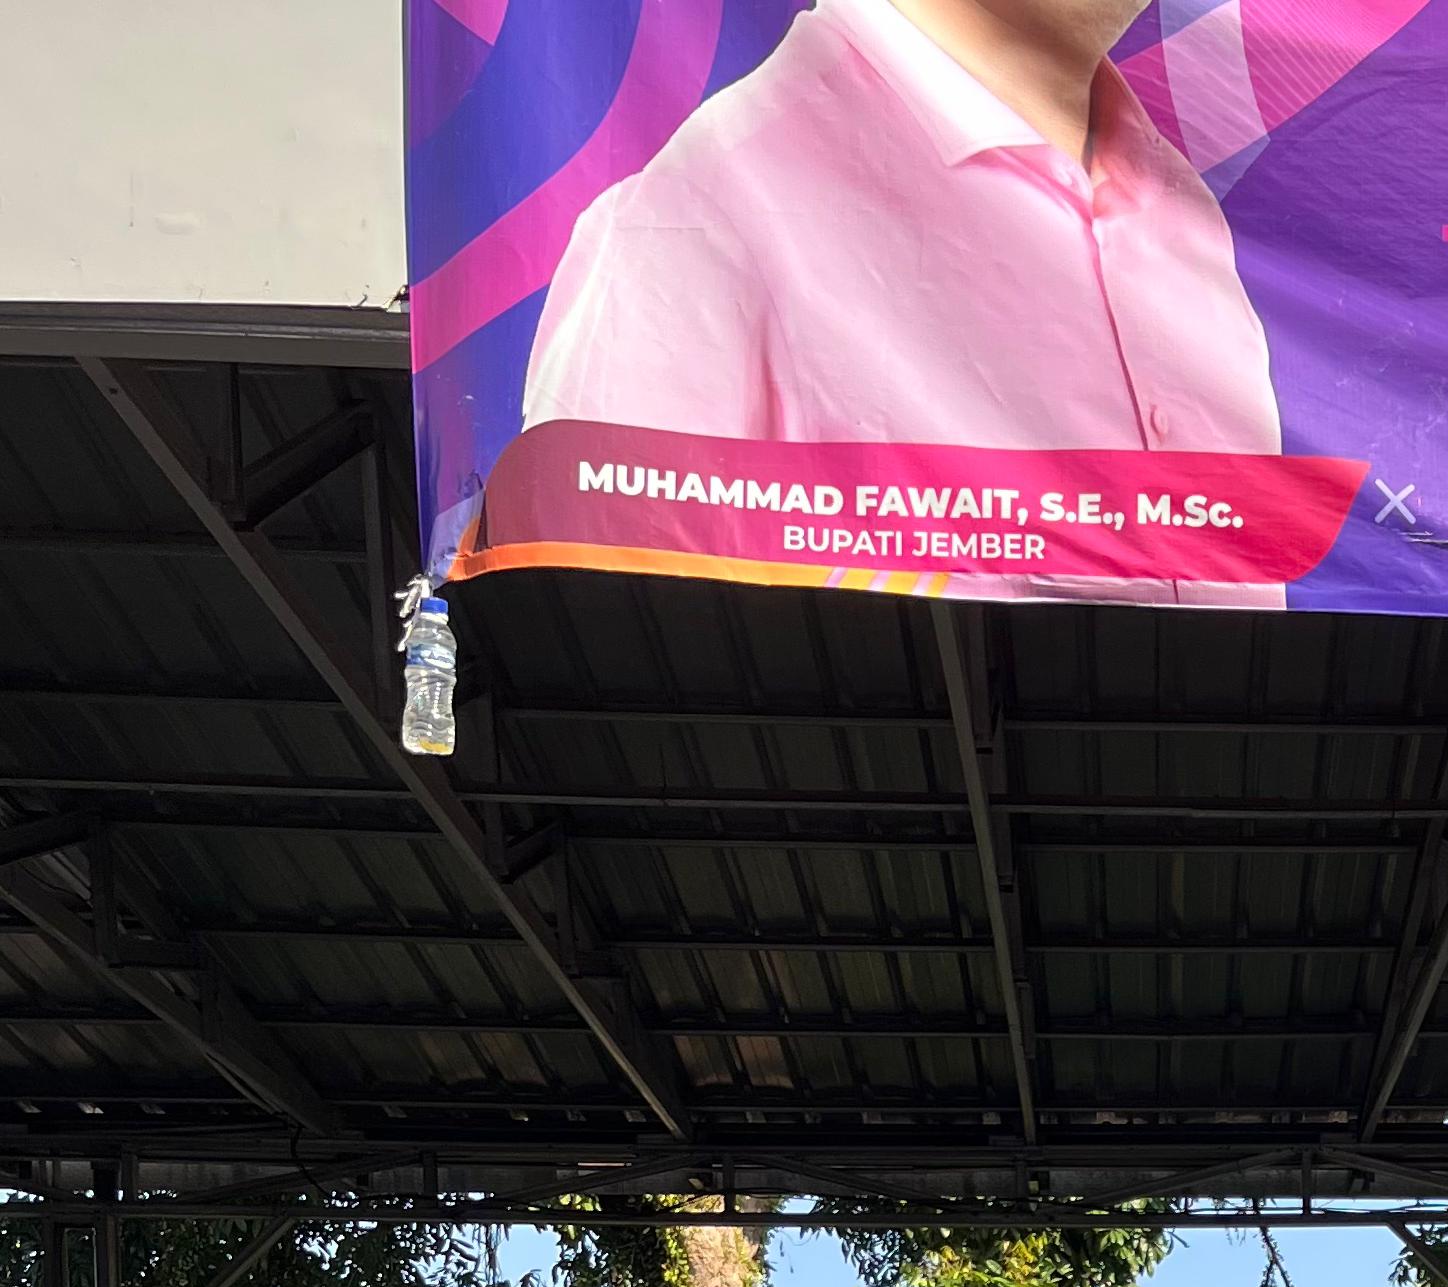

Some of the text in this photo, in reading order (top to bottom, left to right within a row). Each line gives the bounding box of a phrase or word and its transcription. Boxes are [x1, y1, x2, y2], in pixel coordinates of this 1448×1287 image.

[578, 460, 1245, 531] MUHAMMAD FAWAIT, S.E., M.Sc.
[783, 525, 1046, 560] BUPATI JEMBER
